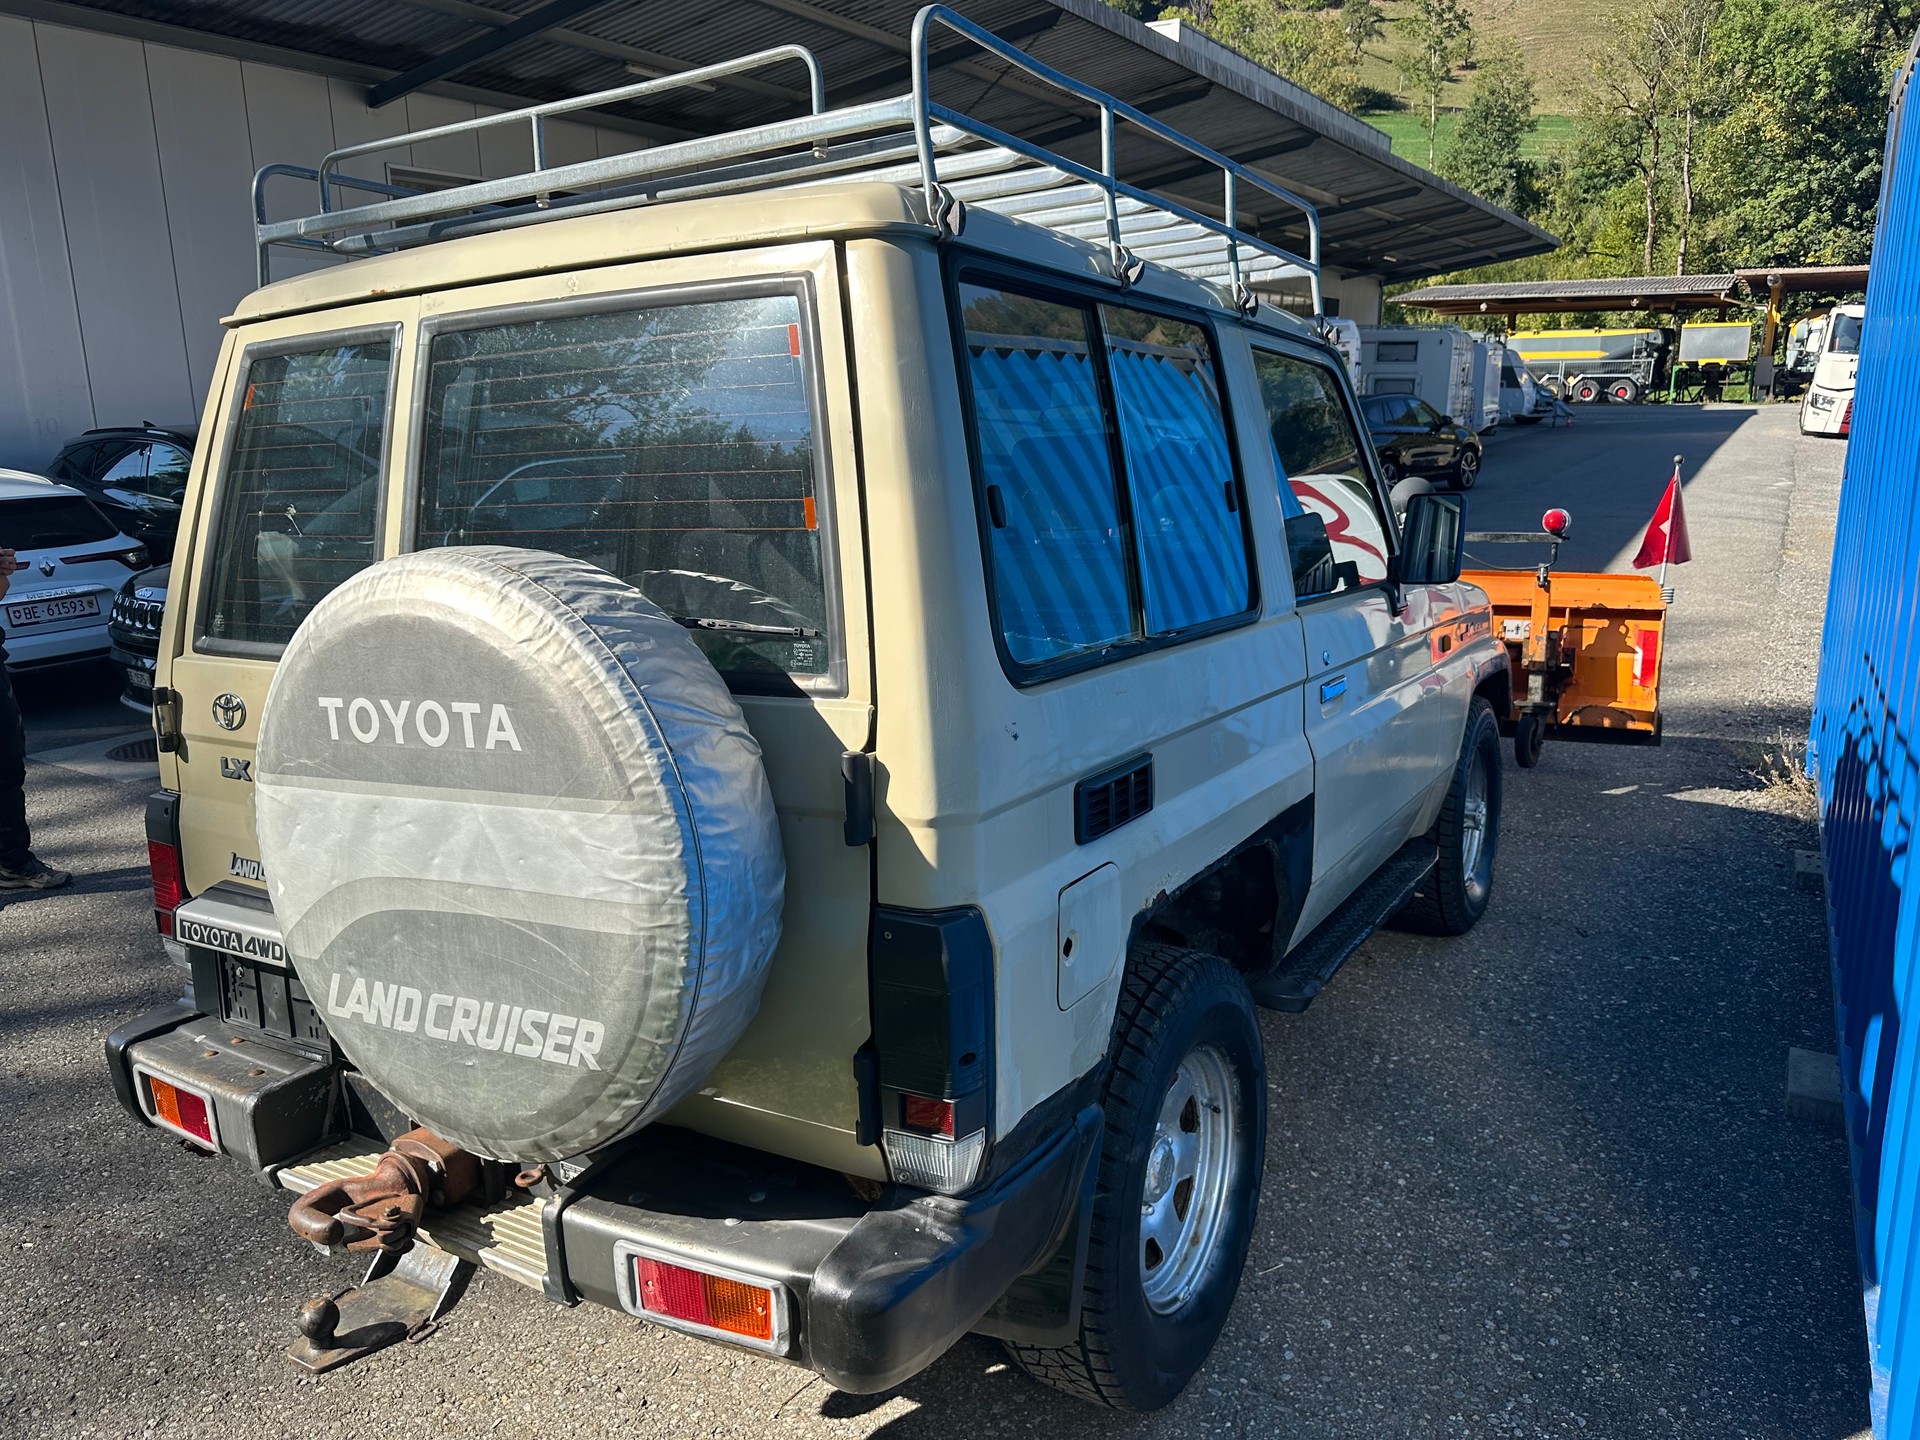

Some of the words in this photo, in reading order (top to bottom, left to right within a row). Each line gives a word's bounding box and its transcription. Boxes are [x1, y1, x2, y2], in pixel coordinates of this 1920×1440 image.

[318, 697, 523, 752] TOYOTA
[220, 757, 253, 782] LX
[182, 921, 241, 952] TOYOTA
[244, 936, 285, 962] 4WD
[327, 972, 423, 1034] LAND
[424, 992, 606, 1072] CRUISER
